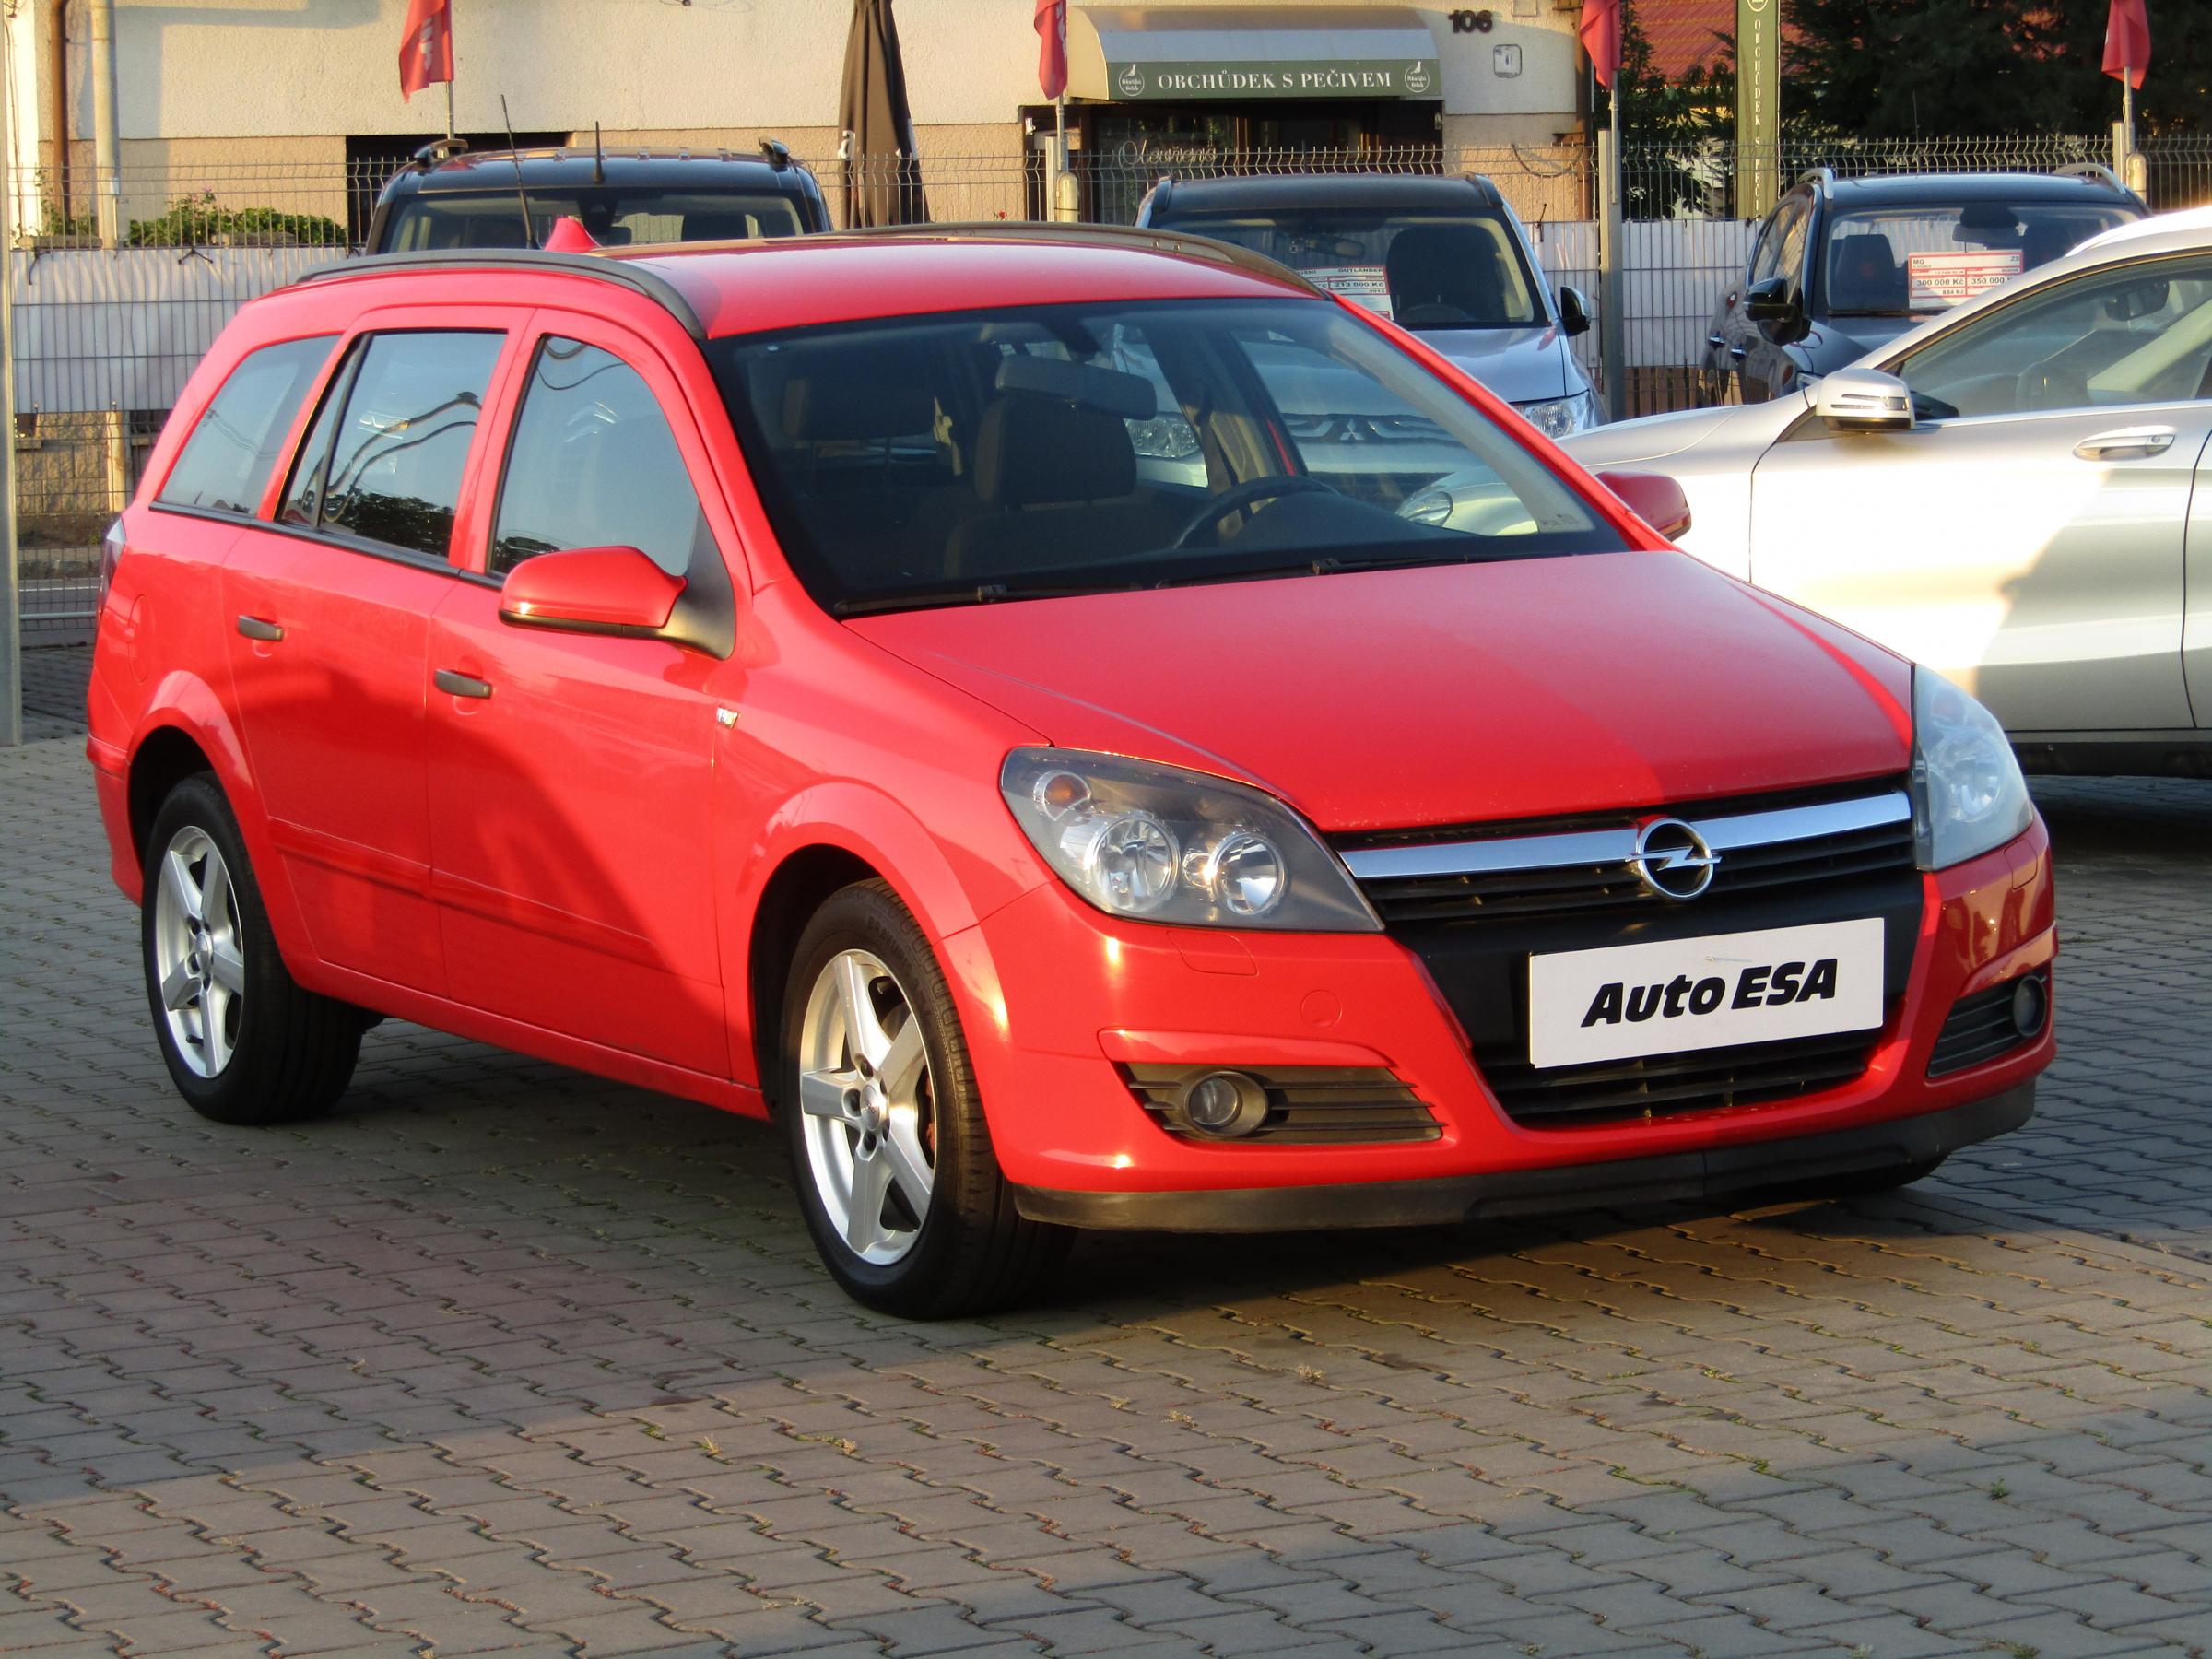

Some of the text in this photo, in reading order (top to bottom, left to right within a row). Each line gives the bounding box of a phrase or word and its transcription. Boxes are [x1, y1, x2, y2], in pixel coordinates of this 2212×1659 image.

[1447, 9, 1493, 33] 106
[1158, 69, 1391, 89] OBCHŮDEK S PEČIVEM
[1580, 959, 1838, 1028] Auto ESA
